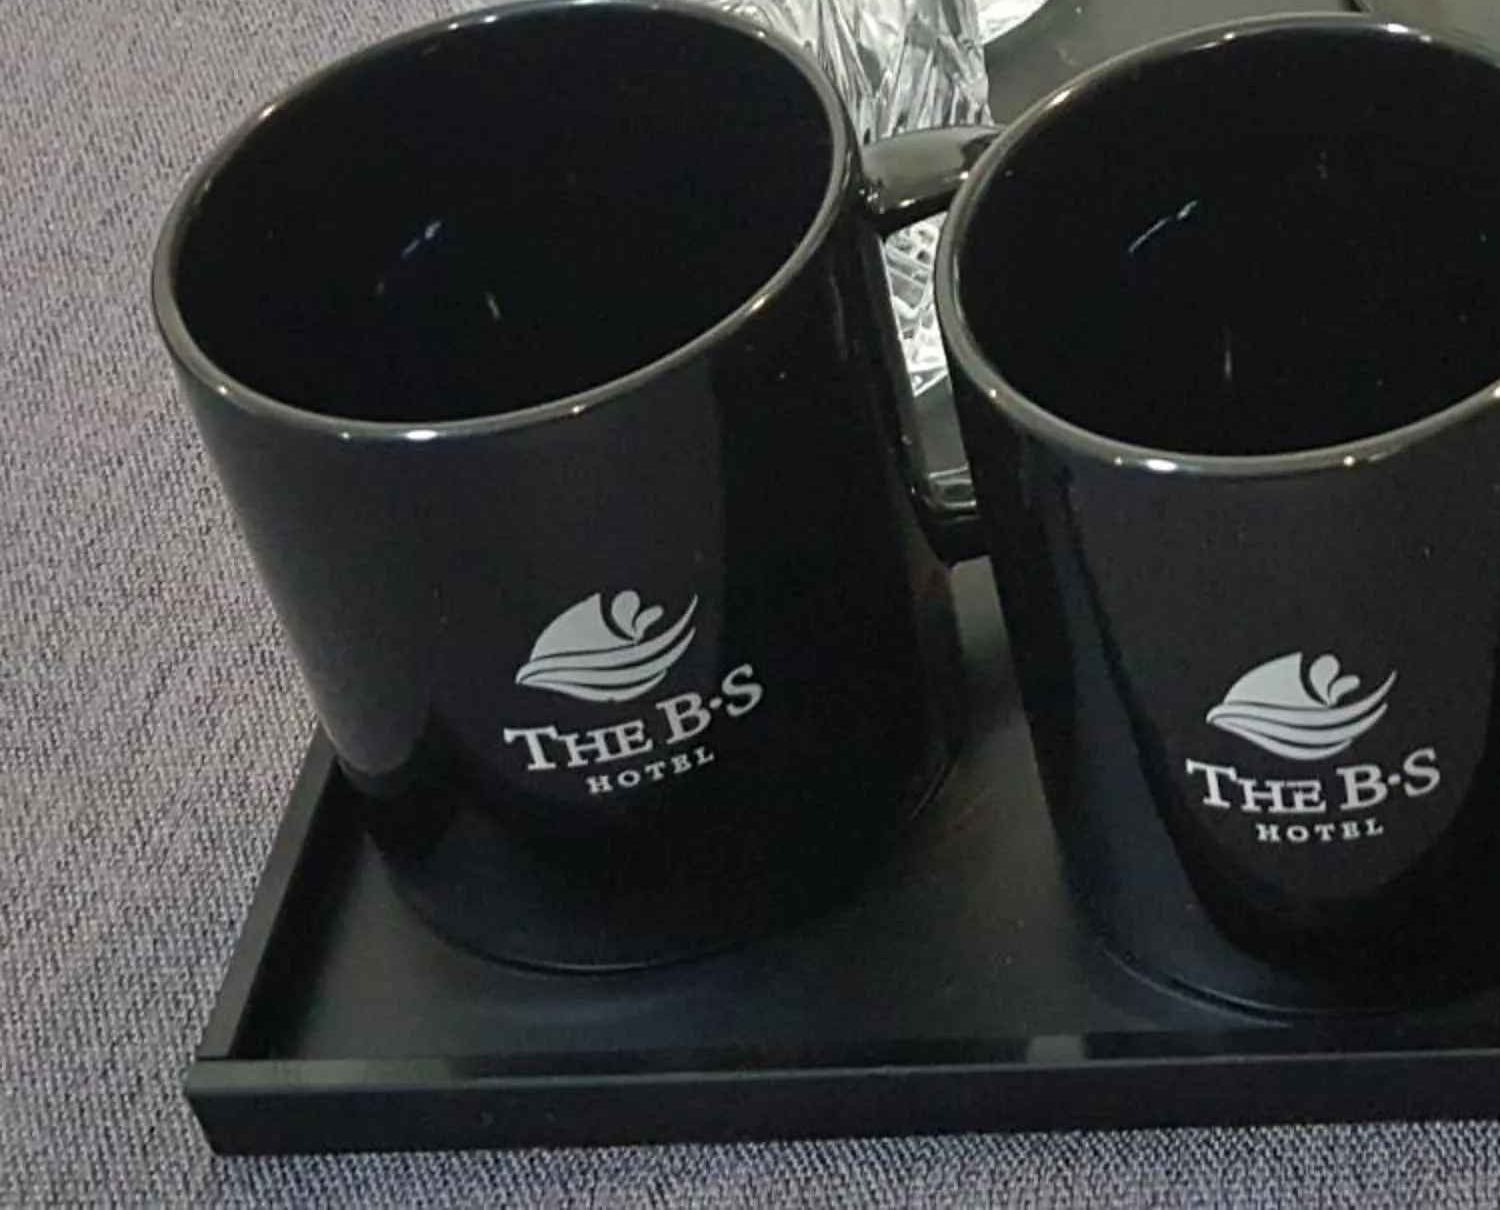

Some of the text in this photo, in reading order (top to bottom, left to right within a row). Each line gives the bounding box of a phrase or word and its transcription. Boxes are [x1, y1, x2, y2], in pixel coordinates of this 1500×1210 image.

[503, 719, 654, 771] THE
[585, 745, 715, 794] HOTEL
[1185, 758, 1327, 814] THE
[1255, 818, 1384, 843] HOTEL
